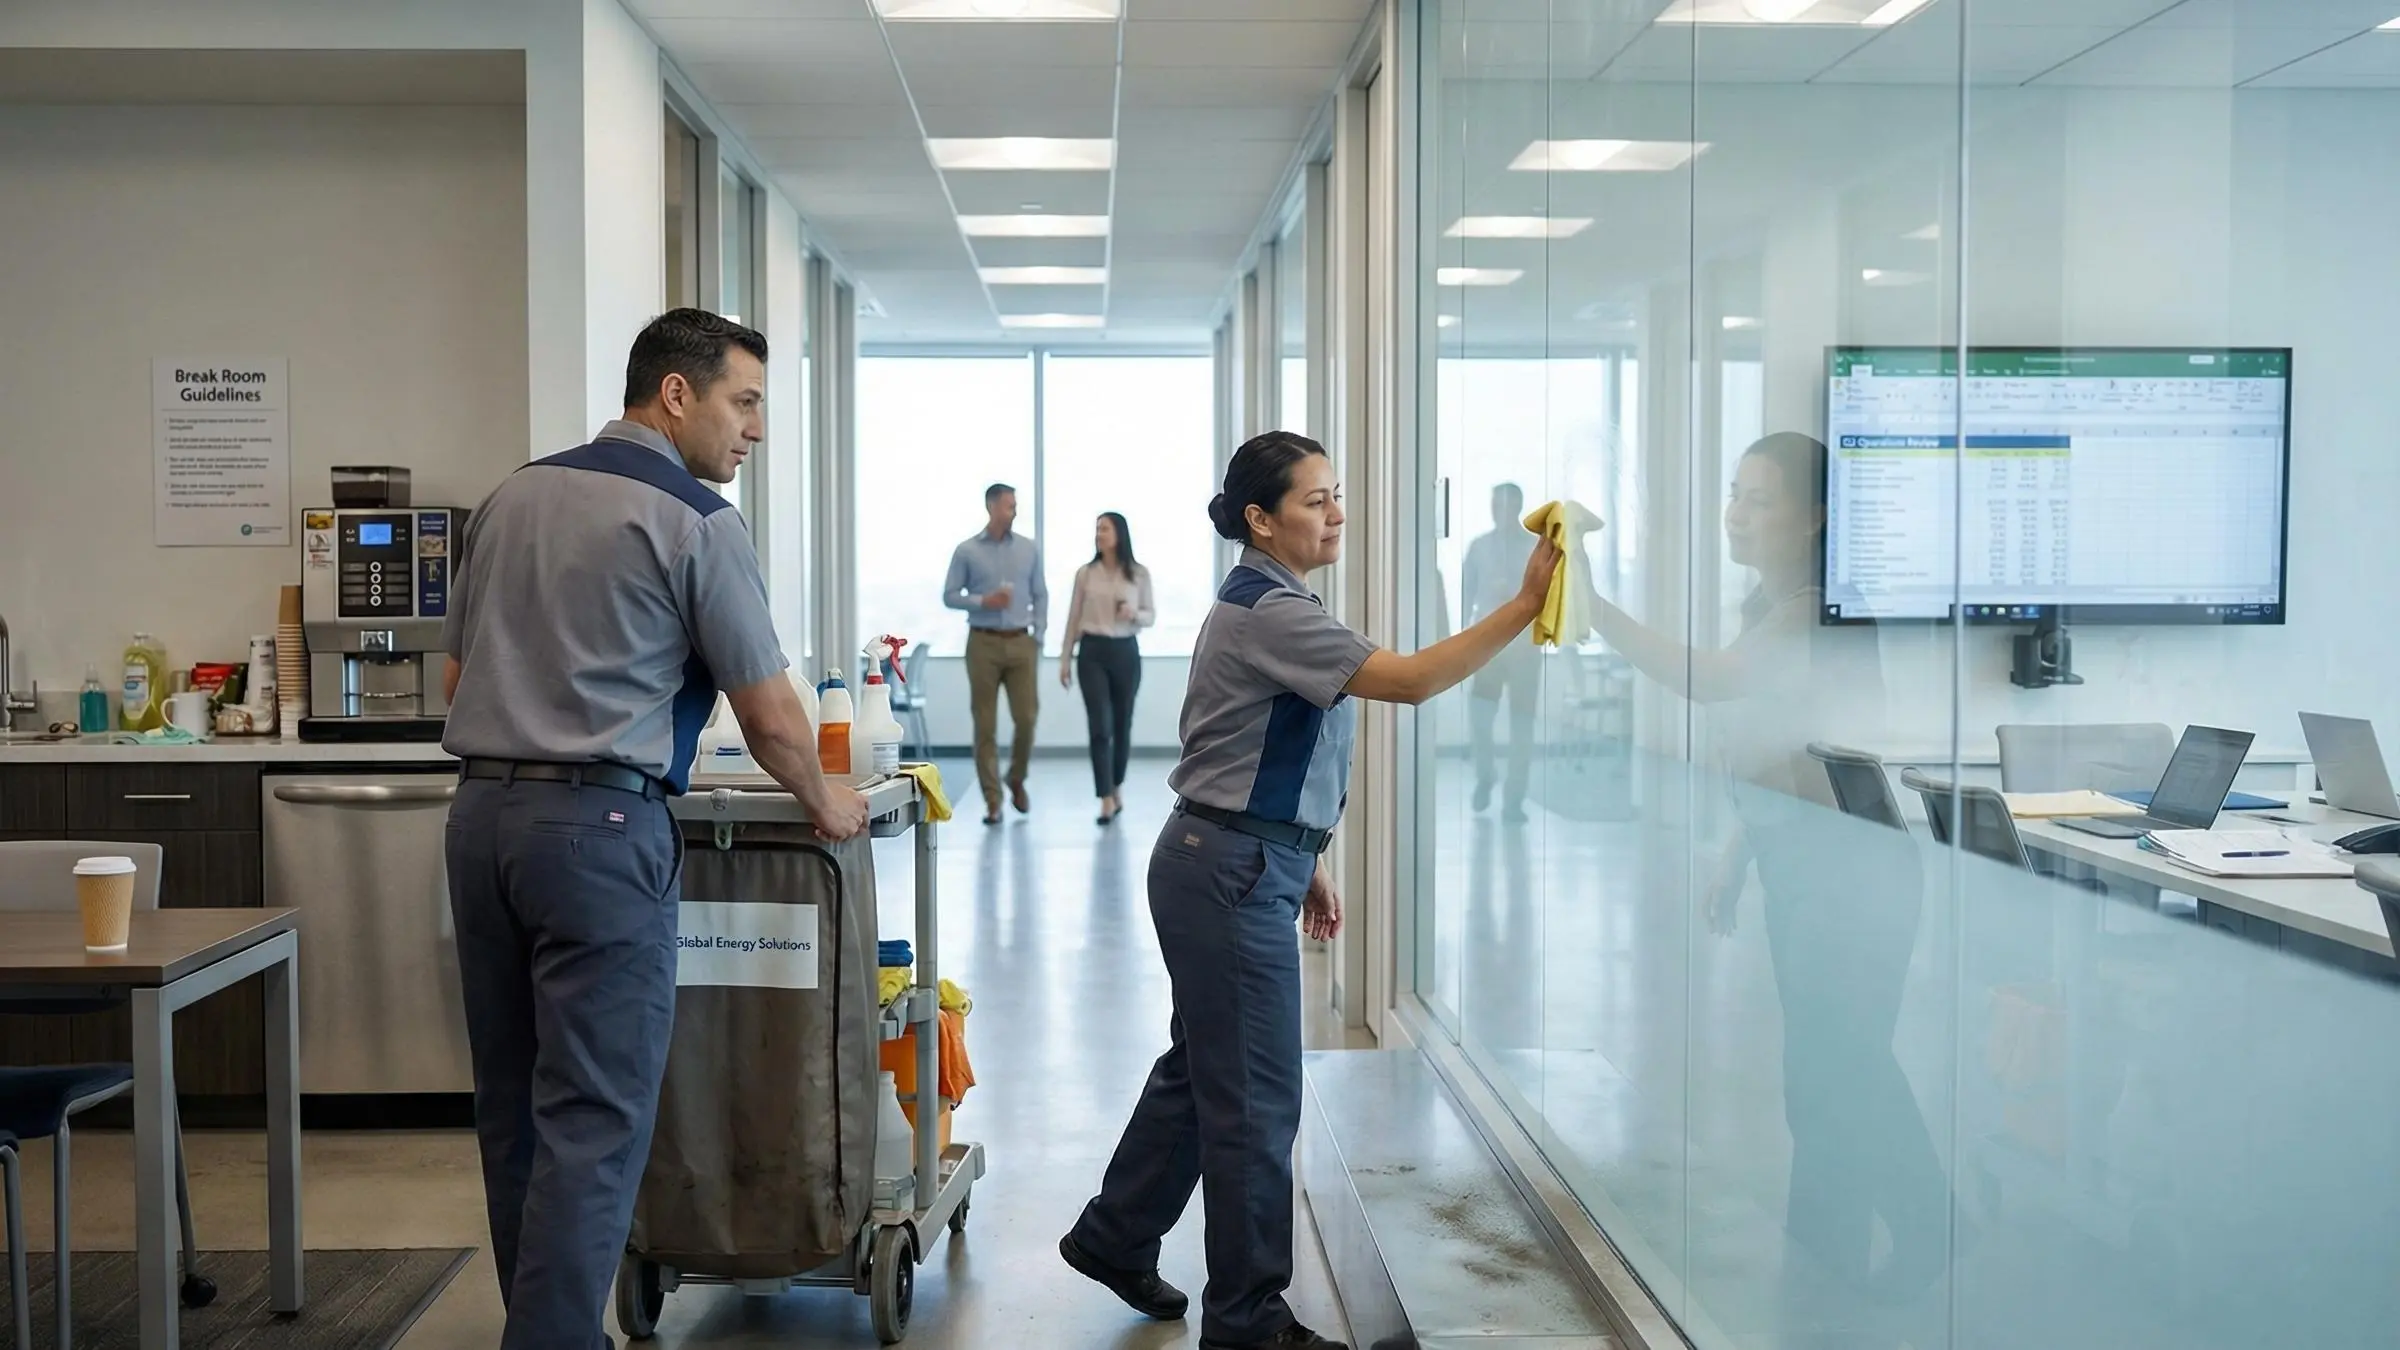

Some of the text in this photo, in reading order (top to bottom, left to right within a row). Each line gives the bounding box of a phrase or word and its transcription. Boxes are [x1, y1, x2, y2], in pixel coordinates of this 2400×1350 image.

[175, 368, 267, 383] Break Room
[180, 386, 262, 402] Guidelines
[716, 936, 757, 952] Energy
[758, 937, 812, 951] Solutions
